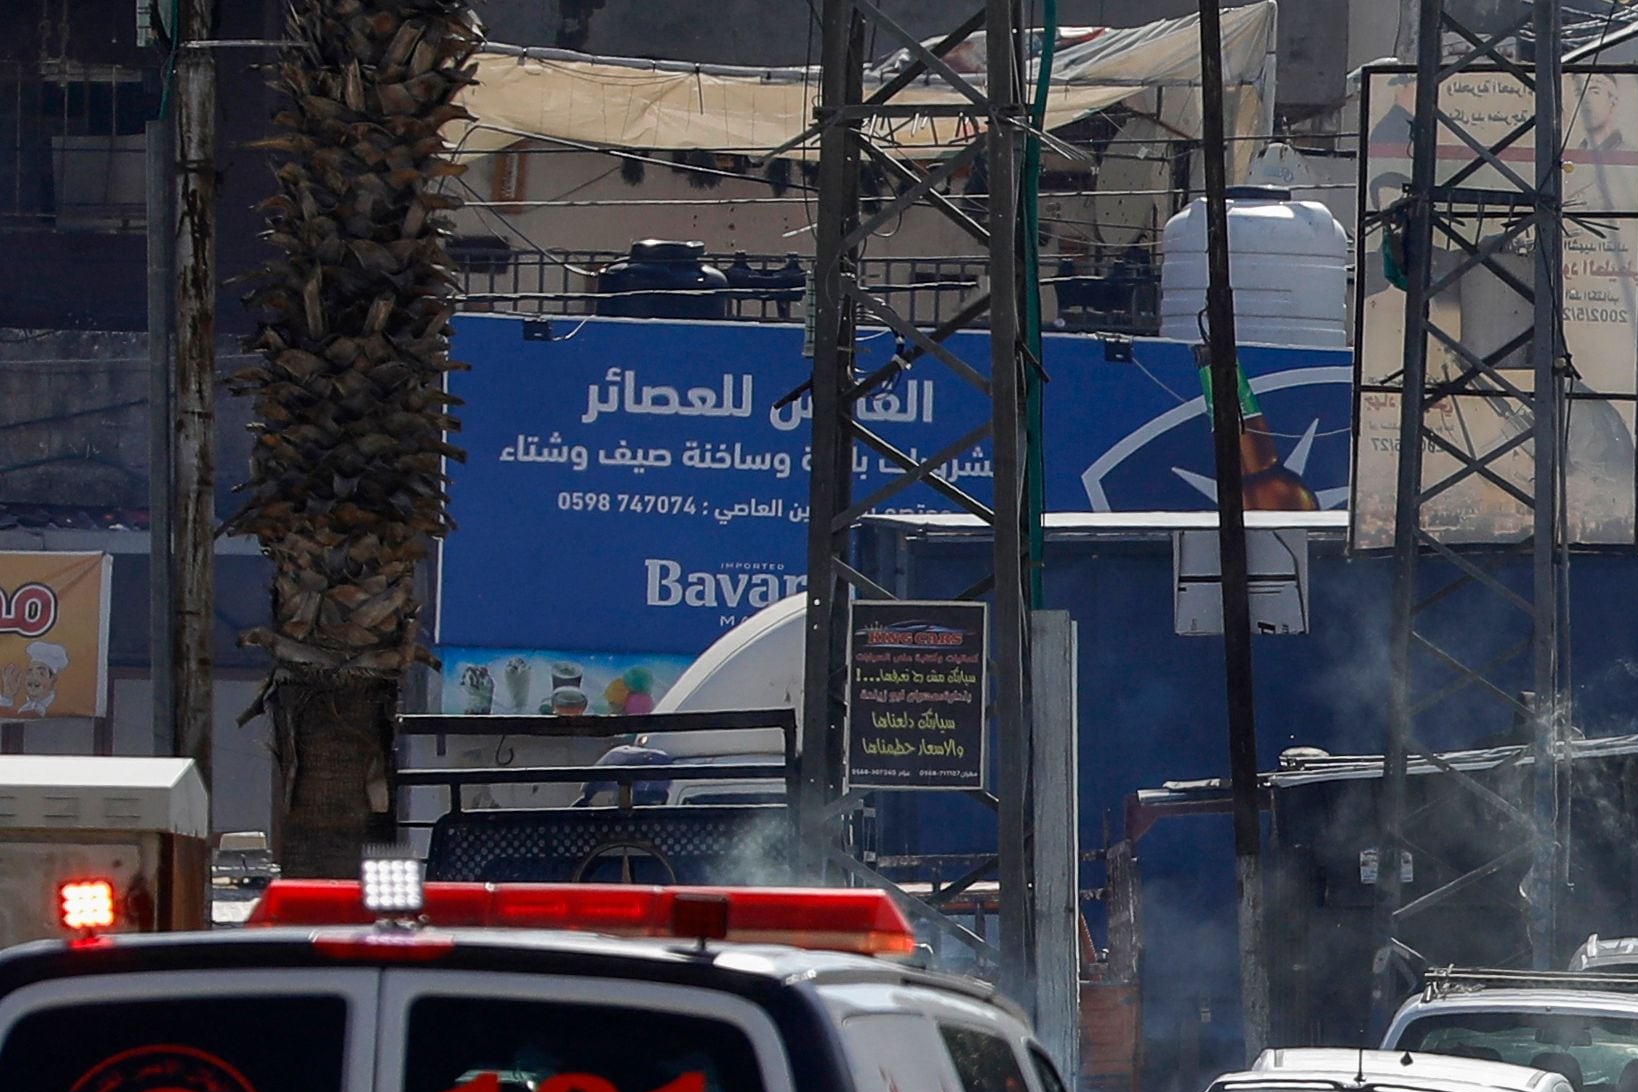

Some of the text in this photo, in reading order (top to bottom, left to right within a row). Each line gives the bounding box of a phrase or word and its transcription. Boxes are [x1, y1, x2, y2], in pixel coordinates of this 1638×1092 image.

[582, 367, 752, 423] للعصائر
[499, 432, 588, 471] وشتاء
[598, 440, 671, 473] صيف
[682, 441, 791, 478] وساخنة
[557, 492, 610, 511] 0598
[617, 495, 696, 515] 747074
[714, 499, 782, 524] العاصي
[721, 562, 785, 570] IMPORTED
[645, 559, 808, 608] Bavar
[868, 631, 964, 646] KING CARS
